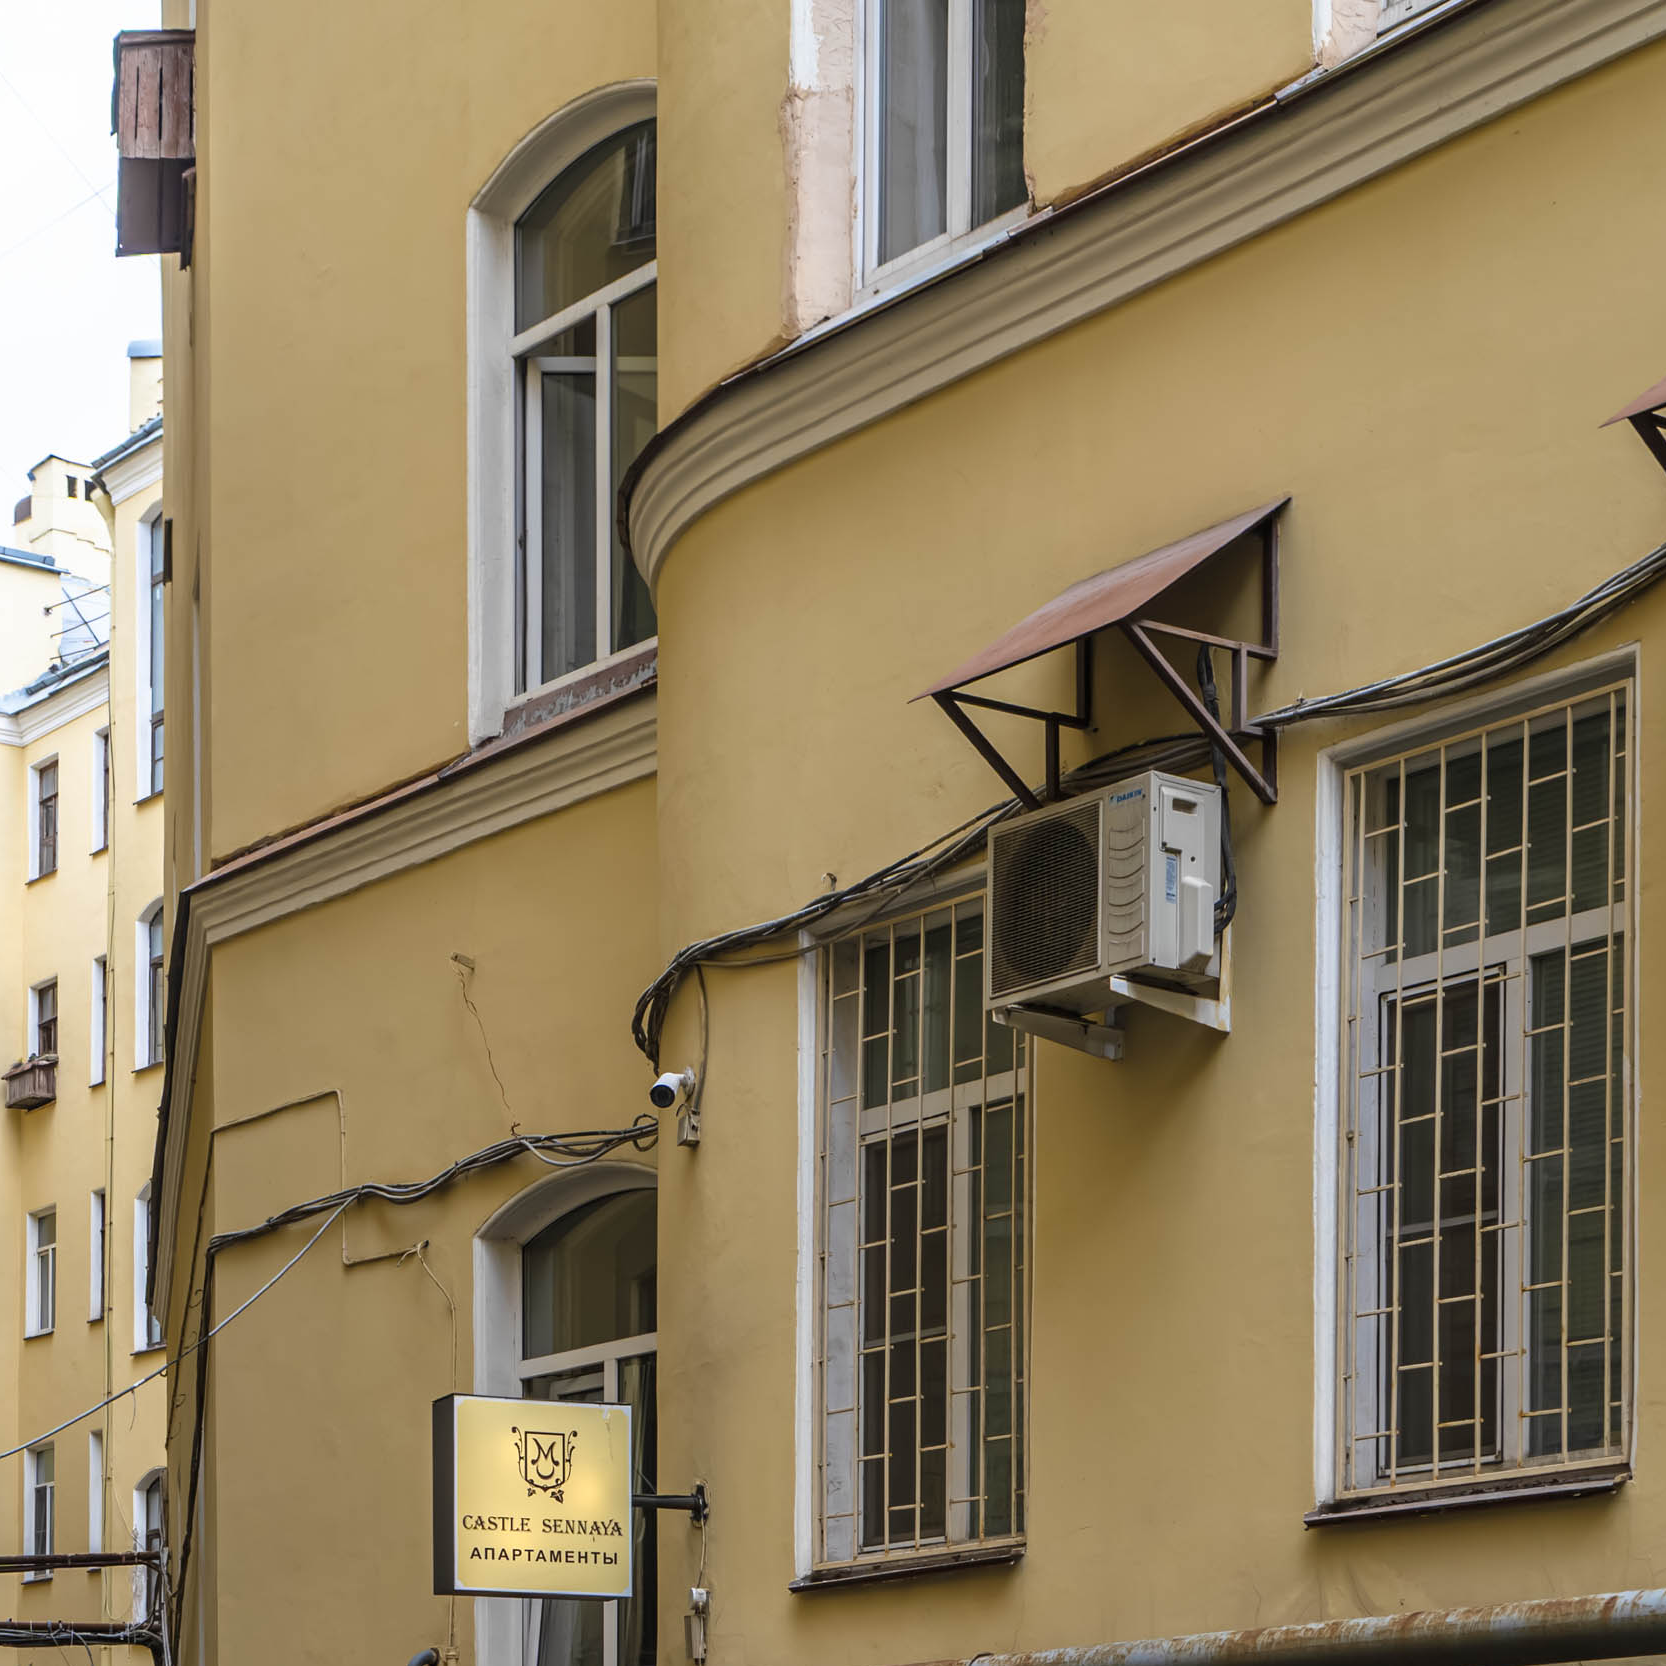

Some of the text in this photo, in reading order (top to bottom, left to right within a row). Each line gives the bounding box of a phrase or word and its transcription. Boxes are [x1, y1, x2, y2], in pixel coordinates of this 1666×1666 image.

[462, 1514, 623, 1536] CASTLE SENNAYA
[470, 1547, 618, 1565] АПАРТАМЕНТЫ
